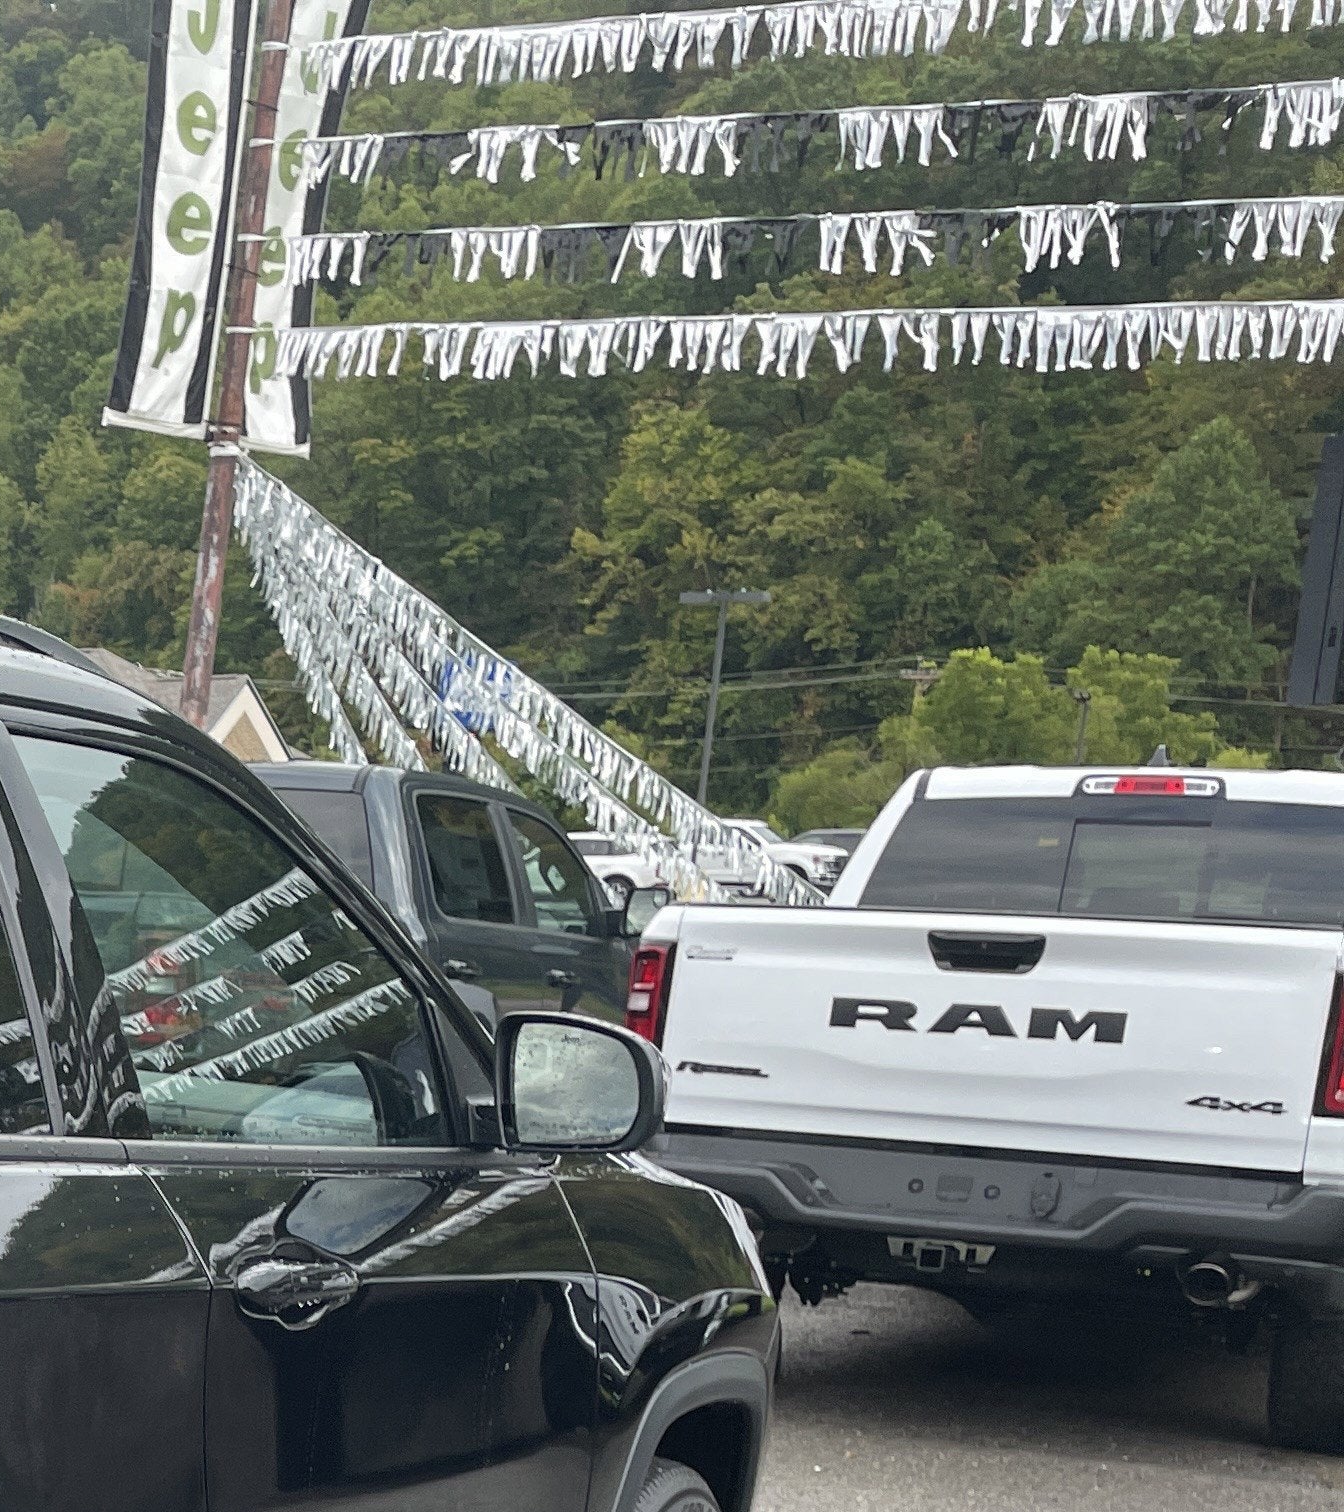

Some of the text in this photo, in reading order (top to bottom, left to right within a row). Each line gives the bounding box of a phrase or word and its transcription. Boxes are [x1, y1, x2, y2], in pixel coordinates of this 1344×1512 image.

[152, 0, 220, 369] Jeep
[829, 997, 1128, 1044] RAM
[1185, 1096, 1287, 1115] 4x4
